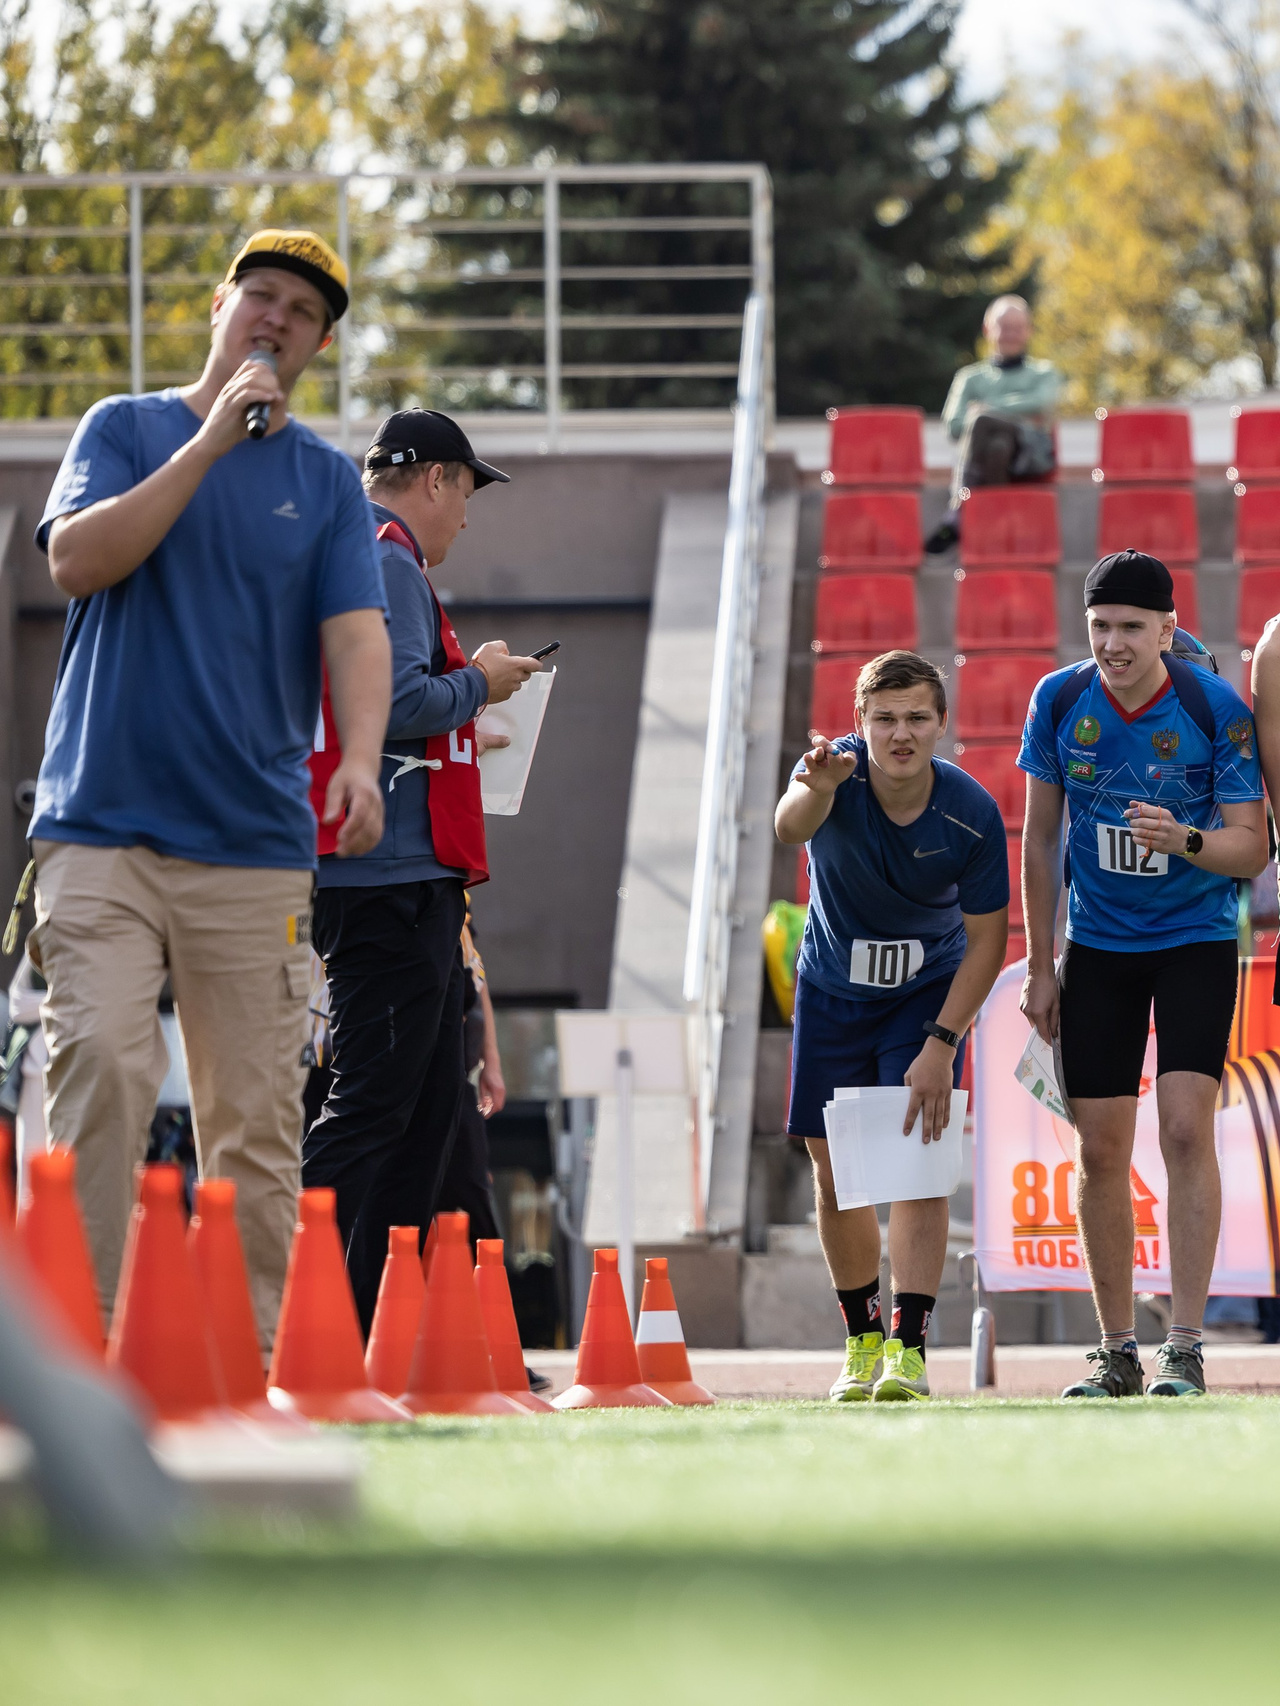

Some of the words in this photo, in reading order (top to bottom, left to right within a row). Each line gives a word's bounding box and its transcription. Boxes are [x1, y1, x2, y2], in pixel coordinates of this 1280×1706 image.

[1072, 765, 1089, 774] SFR
[1106, 827, 1159, 874] 102
[867, 942, 910, 985] 101
[1013, 1239, 1160, 1270] ПОБА!
